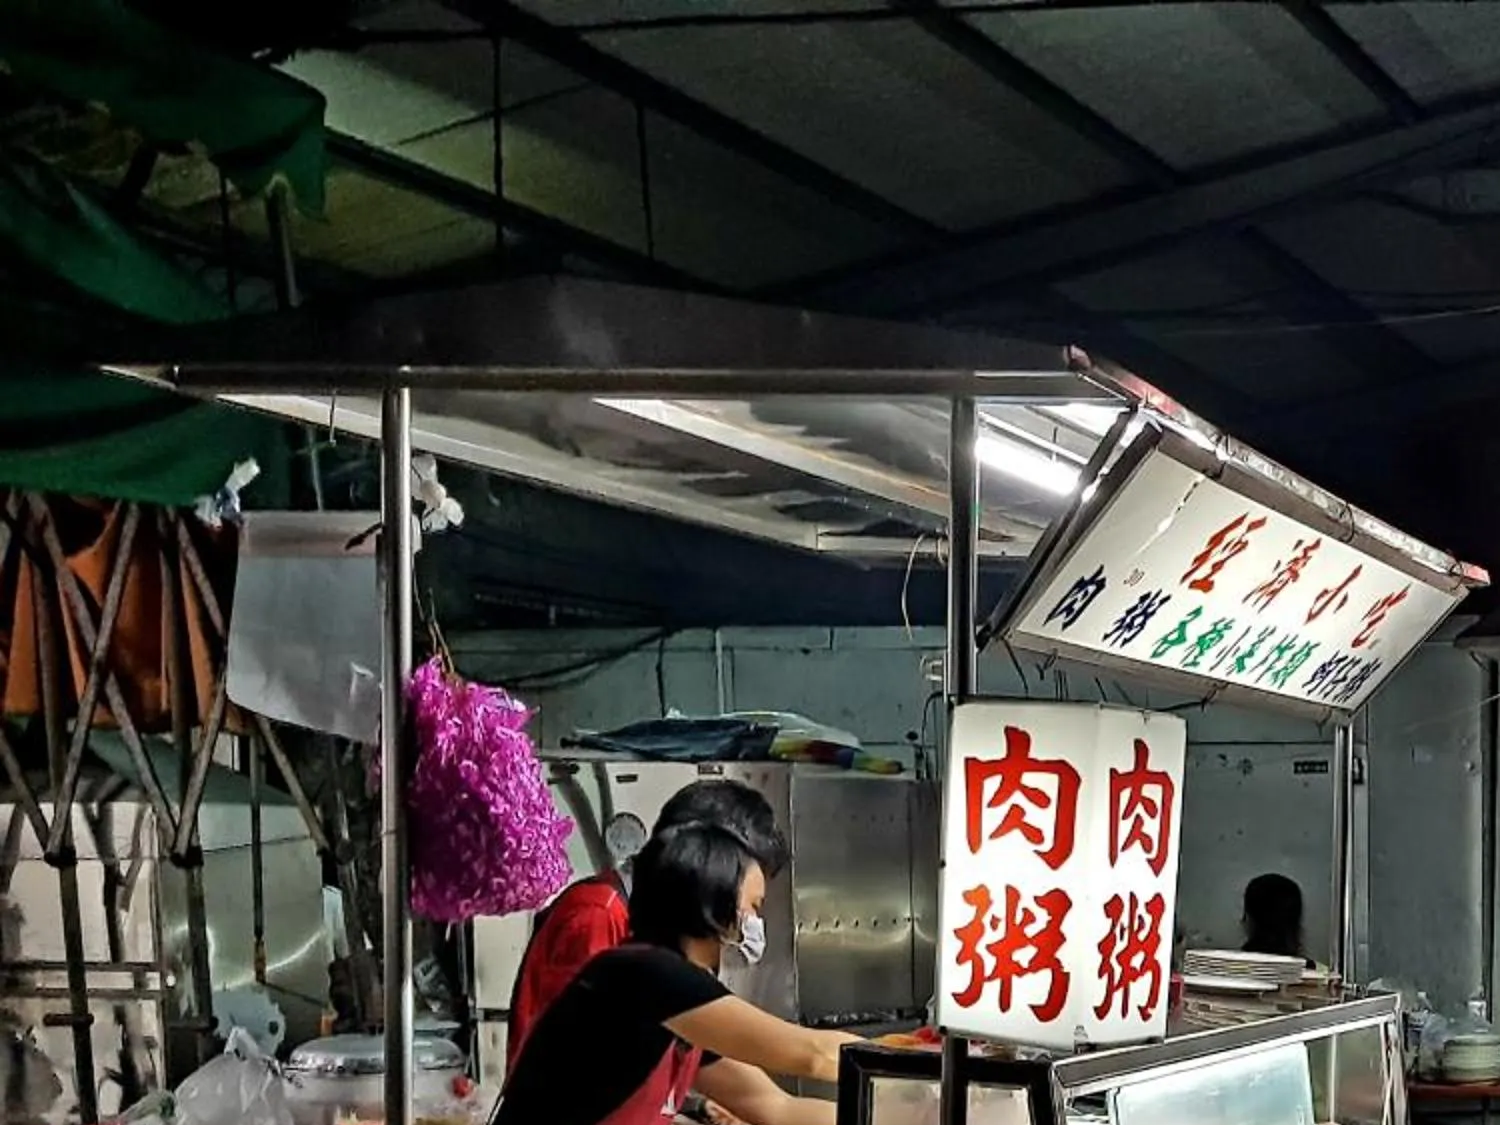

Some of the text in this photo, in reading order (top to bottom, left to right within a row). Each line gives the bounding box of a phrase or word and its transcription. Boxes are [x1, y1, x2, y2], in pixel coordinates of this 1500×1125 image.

[1043, 564, 1172, 648] 肉粥
[1181, 513, 1409, 649] 經濟小吃
[952, 725, 1081, 1022] 肉粥
[1093, 738, 1174, 1022] 肉粥
